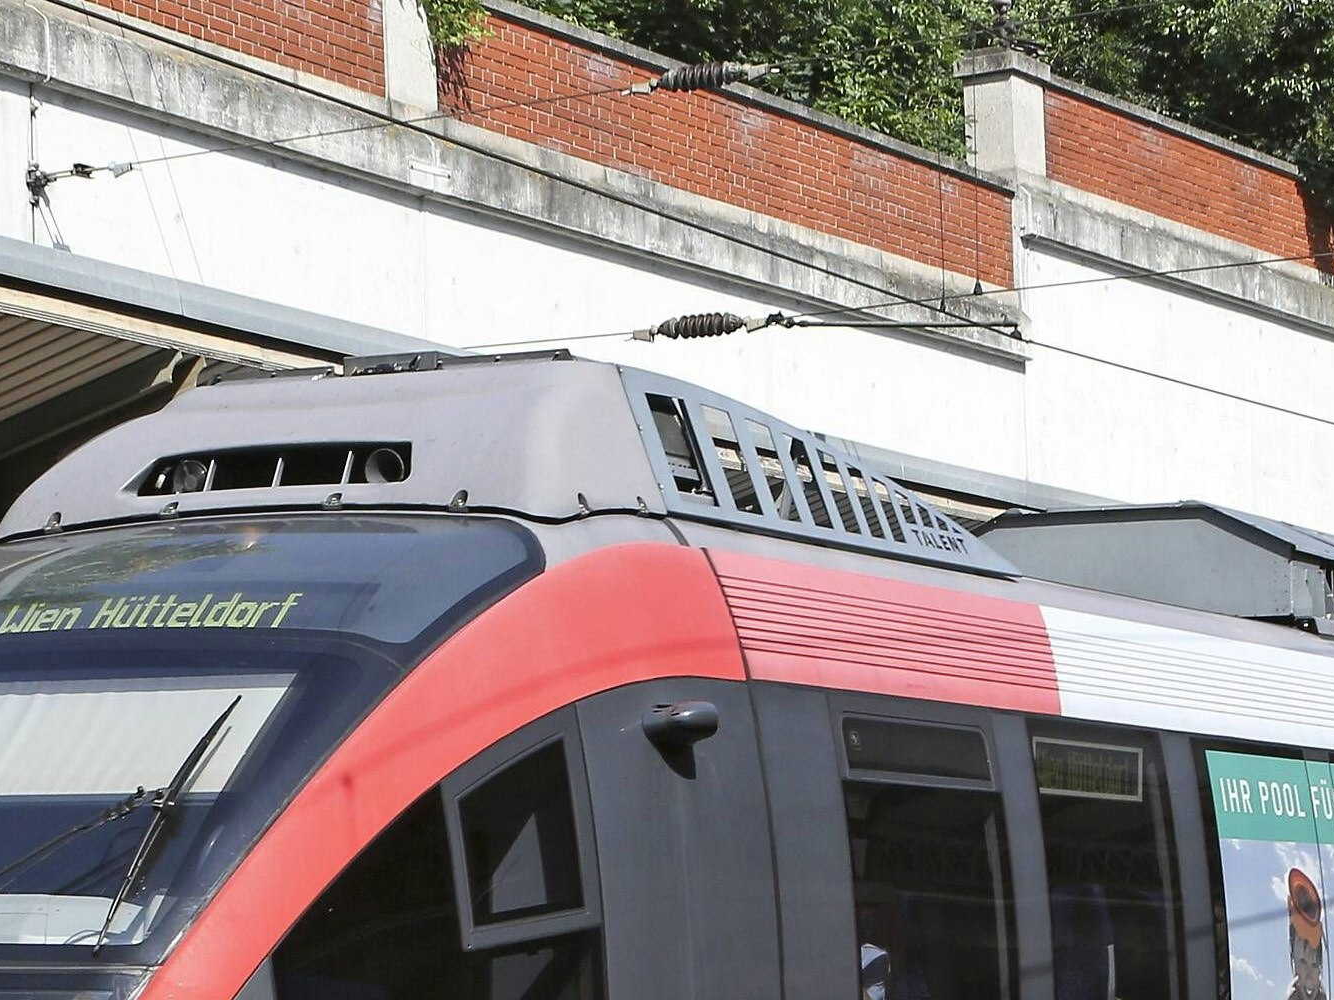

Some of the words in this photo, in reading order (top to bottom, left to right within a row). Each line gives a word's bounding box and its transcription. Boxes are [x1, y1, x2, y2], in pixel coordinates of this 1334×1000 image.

[911, 529, 968, 554] TALENT
[87, 593, 303, 629] Hütteldorf
[1219, 777, 1253, 814] IHR
[1258, 781, 1306, 818] POOL
